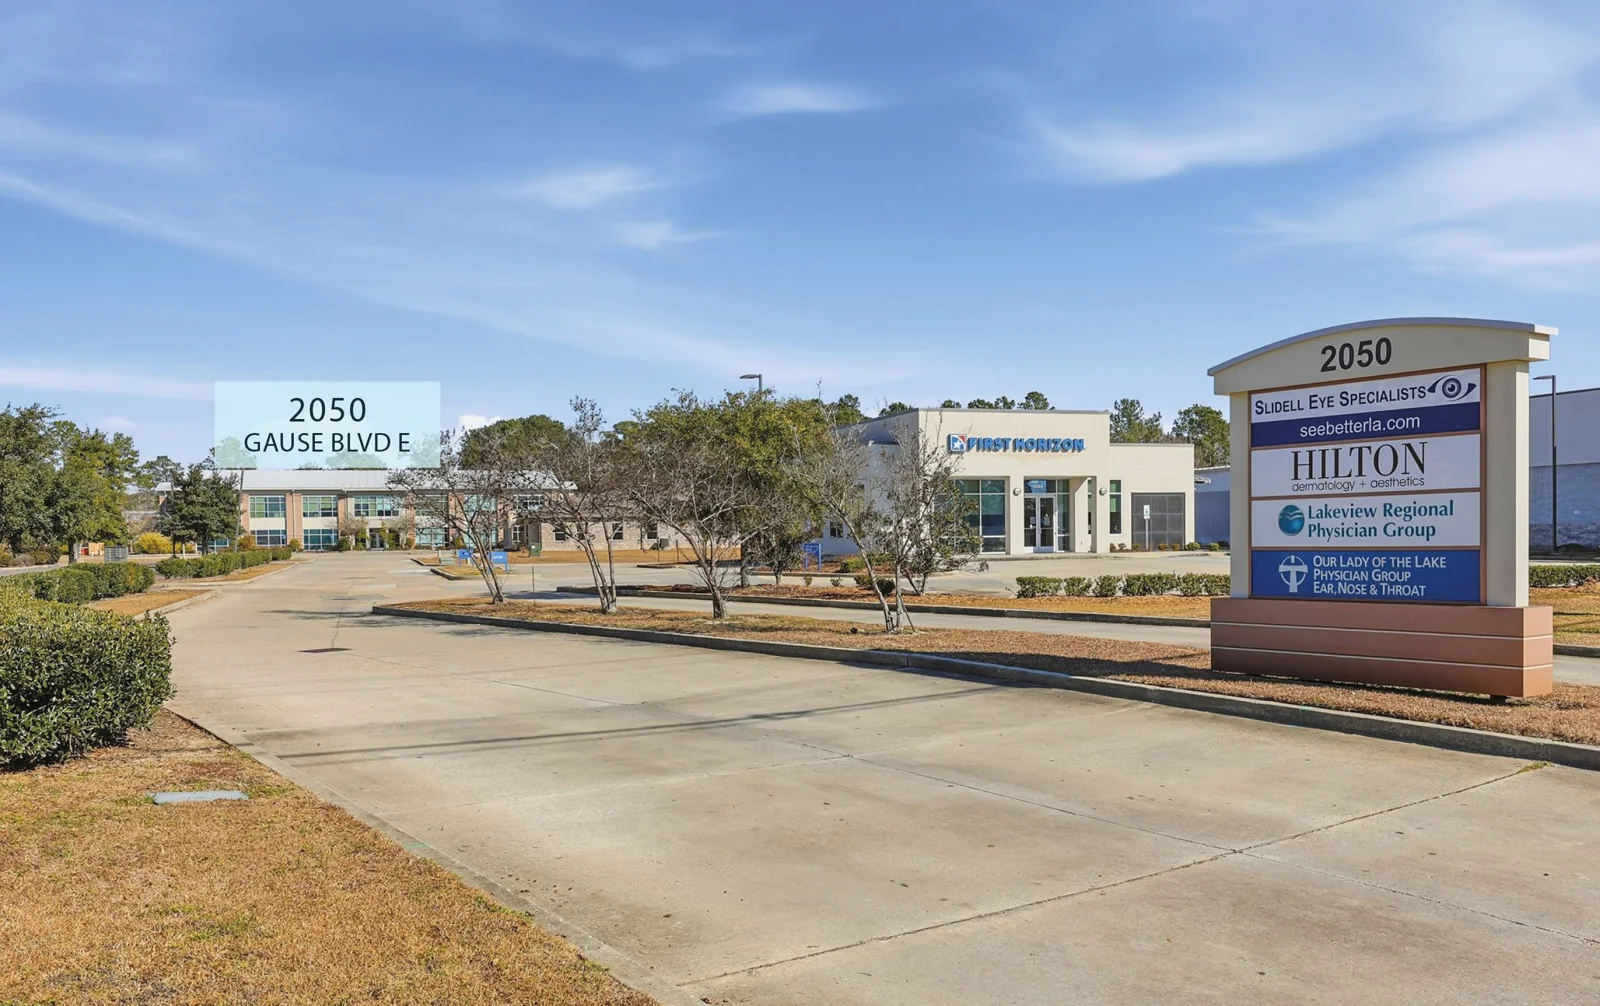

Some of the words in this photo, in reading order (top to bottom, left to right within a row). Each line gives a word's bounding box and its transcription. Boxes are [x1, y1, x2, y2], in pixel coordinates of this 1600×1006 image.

[1320, 337, 1392, 372] 2050
[1300, 415, 1420, 437] seebetterla.com
[967, 437, 1012, 452] FIRST
[1012, 438, 1086, 453] HORIZON
[1291, 441, 1428, 481] HILTON
[1292, 478, 1355, 492] dermatology
[1370, 476, 1425, 488] aesthetics
[1308, 503, 1377, 519] Lakeview
[1383, 499, 1454, 522] Regional
[1308, 522, 1377, 542] Physician
[1383, 521, 1436, 542] Group
[1313, 555, 1337, 567] OUR
[1339, 555, 1369, 568] LADY
[1371, 556, 1387, 568] OF
[1389, 556, 1411, 568] THE
[1414, 555, 1447, 568] LAKE
[1313, 568, 1369, 581] PHYSICIAN
[1371, 569, 1411, 582] GROUP
[1369, 583, 1378, 595] &
[1380, 582, 1426, 596] THROAT
